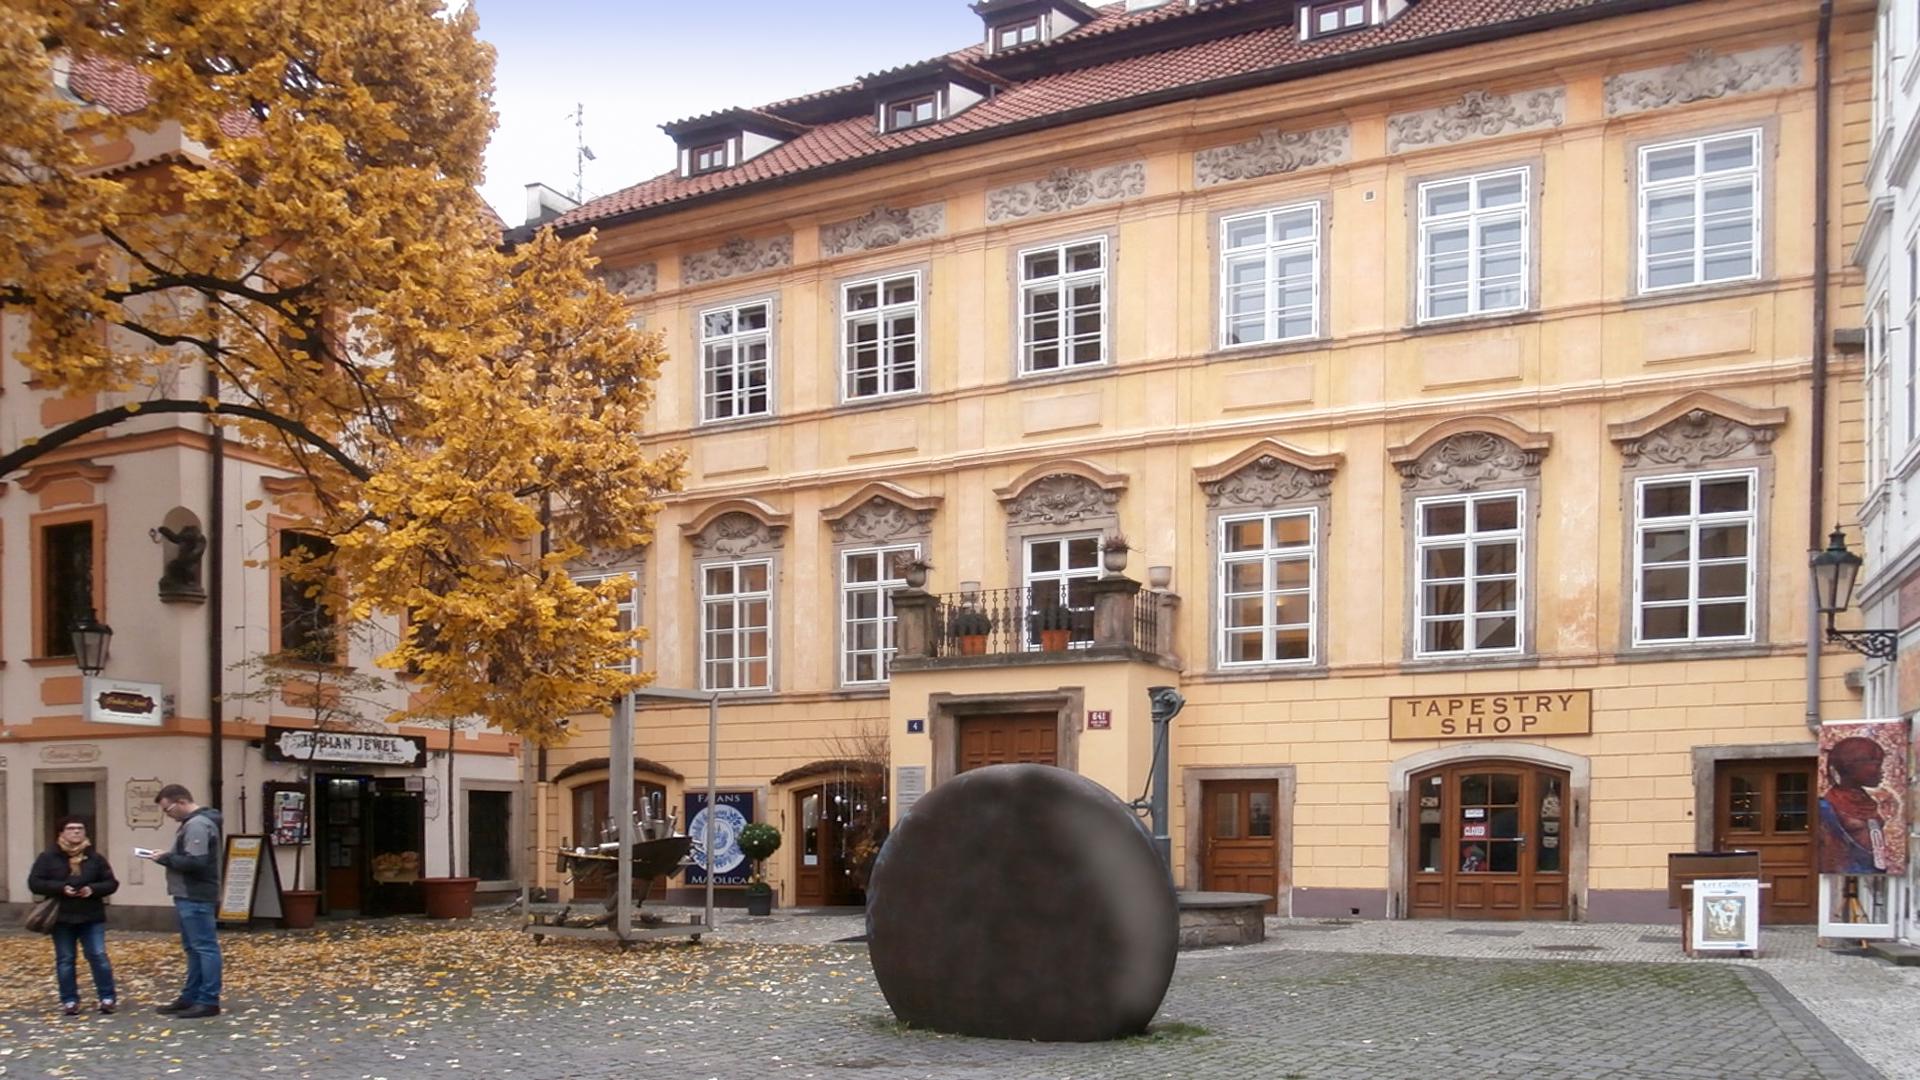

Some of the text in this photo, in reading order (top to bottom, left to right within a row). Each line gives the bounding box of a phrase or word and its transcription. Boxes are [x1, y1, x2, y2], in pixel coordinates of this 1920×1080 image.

[1407, 694, 1573, 717] TAPESTRY
[912, 721, 919, 731] 4
[1441, 715, 1538, 735] SHOP
[356, 737, 400, 752] JEWEL
[698, 793, 741, 803] FAANS
[691, 875, 748, 885] MAOLICA
